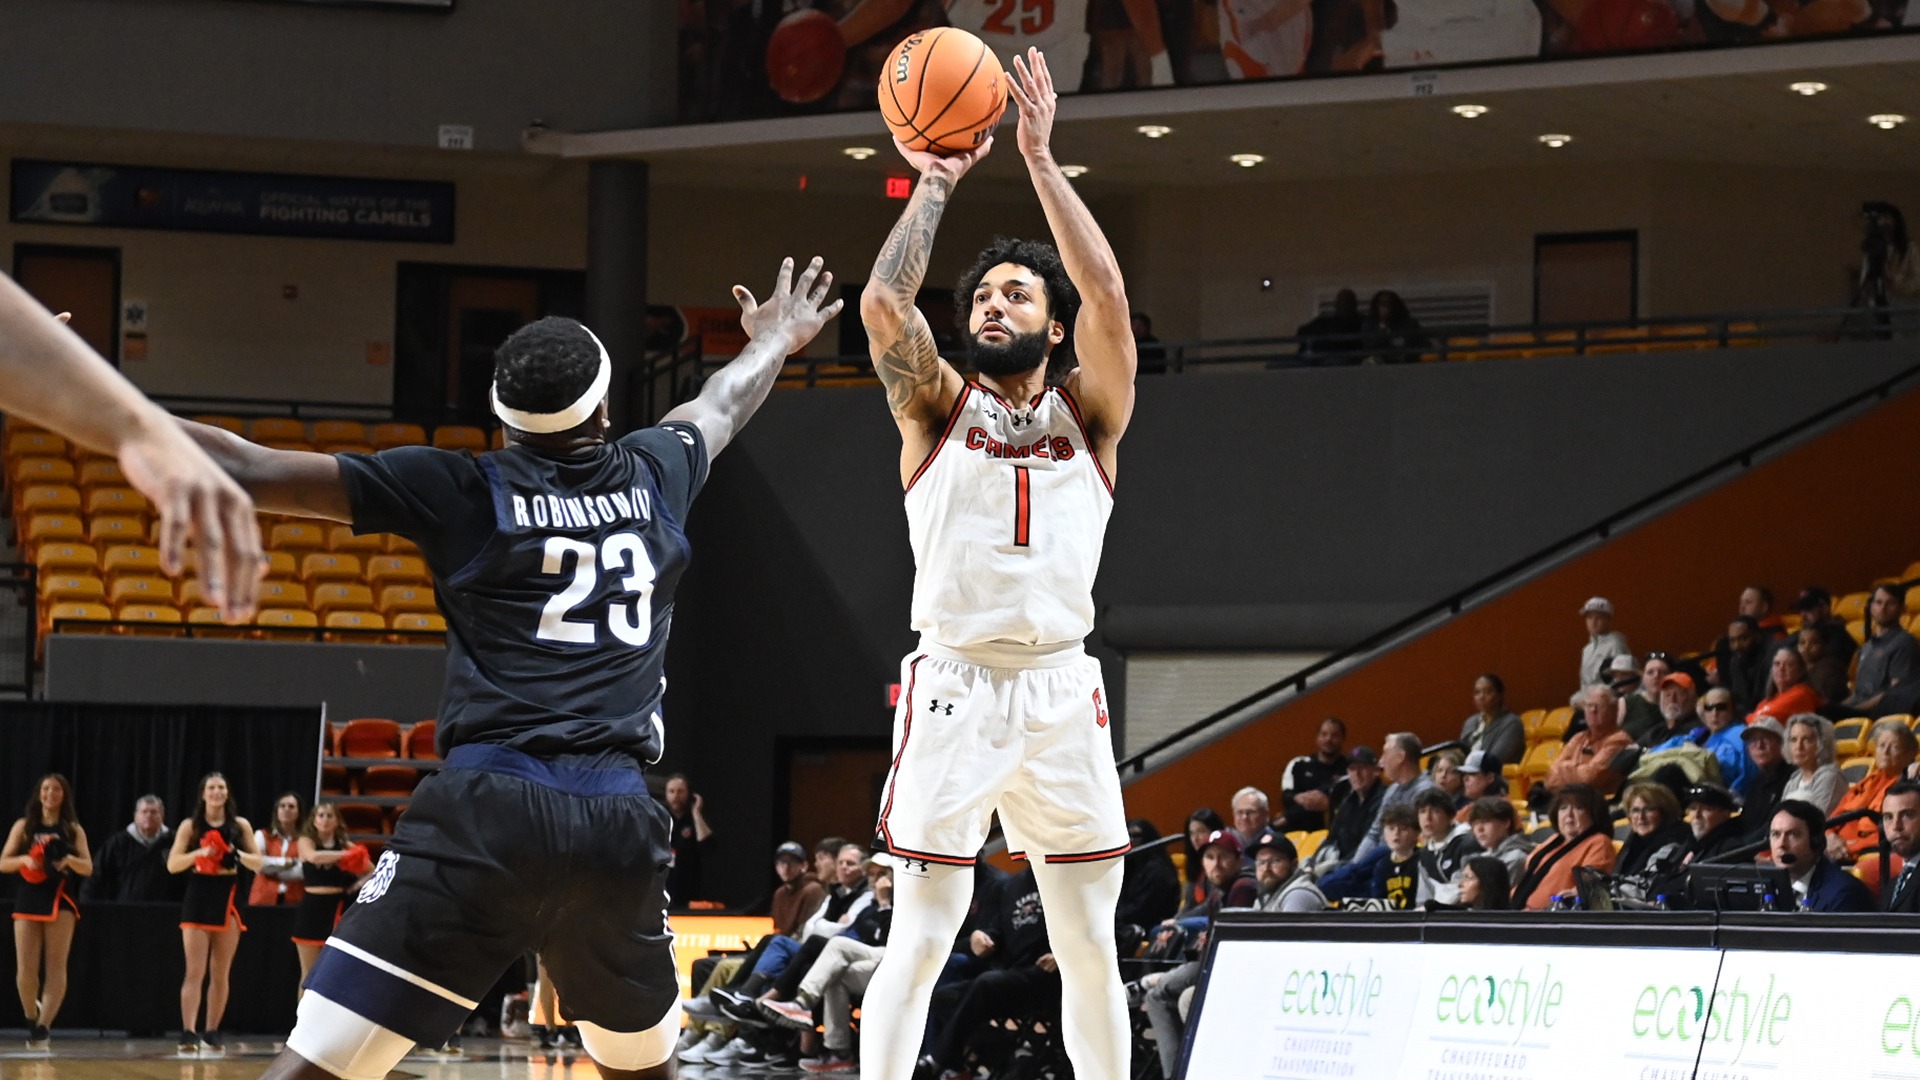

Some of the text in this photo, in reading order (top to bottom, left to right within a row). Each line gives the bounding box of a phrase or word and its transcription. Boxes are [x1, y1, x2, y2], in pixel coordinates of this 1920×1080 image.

[983, 0, 1055, 35] 25
[260, 205, 433, 228] FIGHTING CAMELS
[1014, 466, 1030, 547] 1
[536, 532, 657, 646] 23
[1280, 957, 1383, 1035] ecostyle
[1435, 963, 1563, 1047] ecostyle
[1632, 972, 1793, 1067] ecostyle
[1271, 1056, 1357, 1077] TRANSPORTATION
[1283, 1036, 1353, 1056] CHAUFFEURED
[1440, 1048, 1527, 1070] CHAUFFEURED
